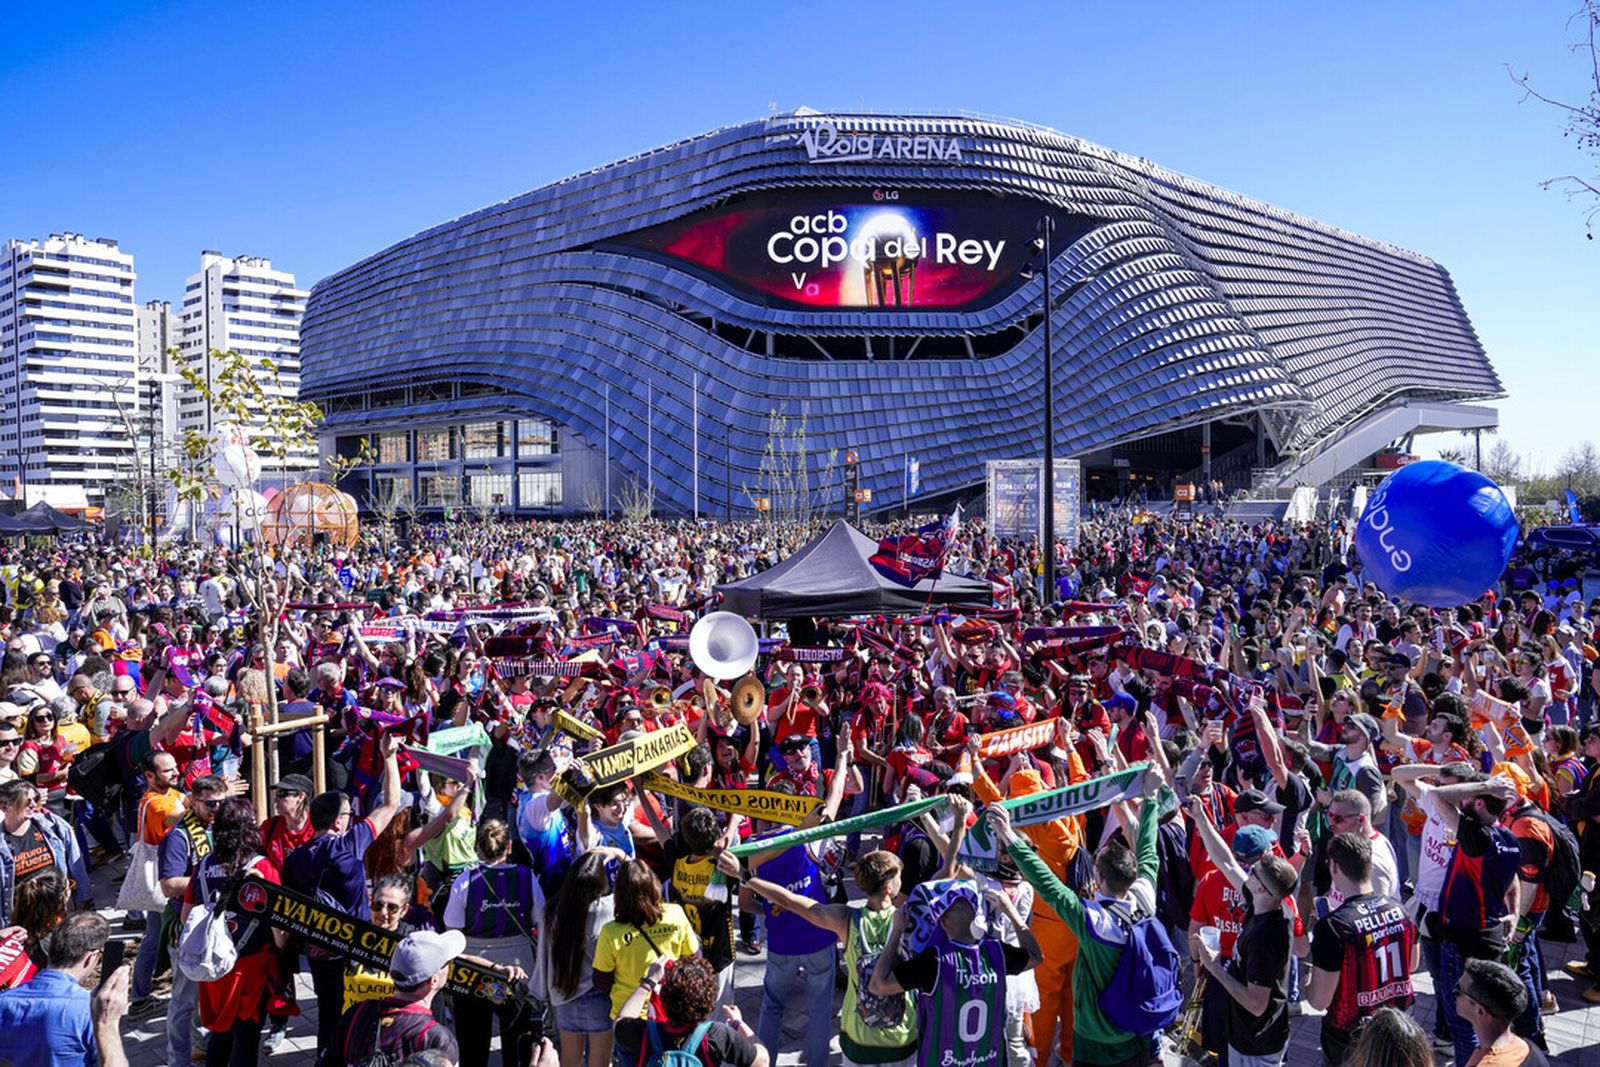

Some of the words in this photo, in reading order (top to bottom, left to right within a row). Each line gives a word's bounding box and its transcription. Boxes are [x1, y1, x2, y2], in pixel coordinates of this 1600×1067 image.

[878, 138, 962, 160] ARENA
[885, 190, 899, 200] LG
[790, 210, 848, 234] acb
[767, 231, 876, 268] Copa
[884, 237, 926, 259] del
[936, 232, 1005, 270] Rey
[592, 749, 635, 778] VAMOS
[636, 726, 689, 763] CANARIAS
[1354, 906, 1405, 933] PELLICER
[1375, 941, 1403, 983] 11
[956, 968, 998, 989] Tyson
[958, 999, 988, 1043] 0
